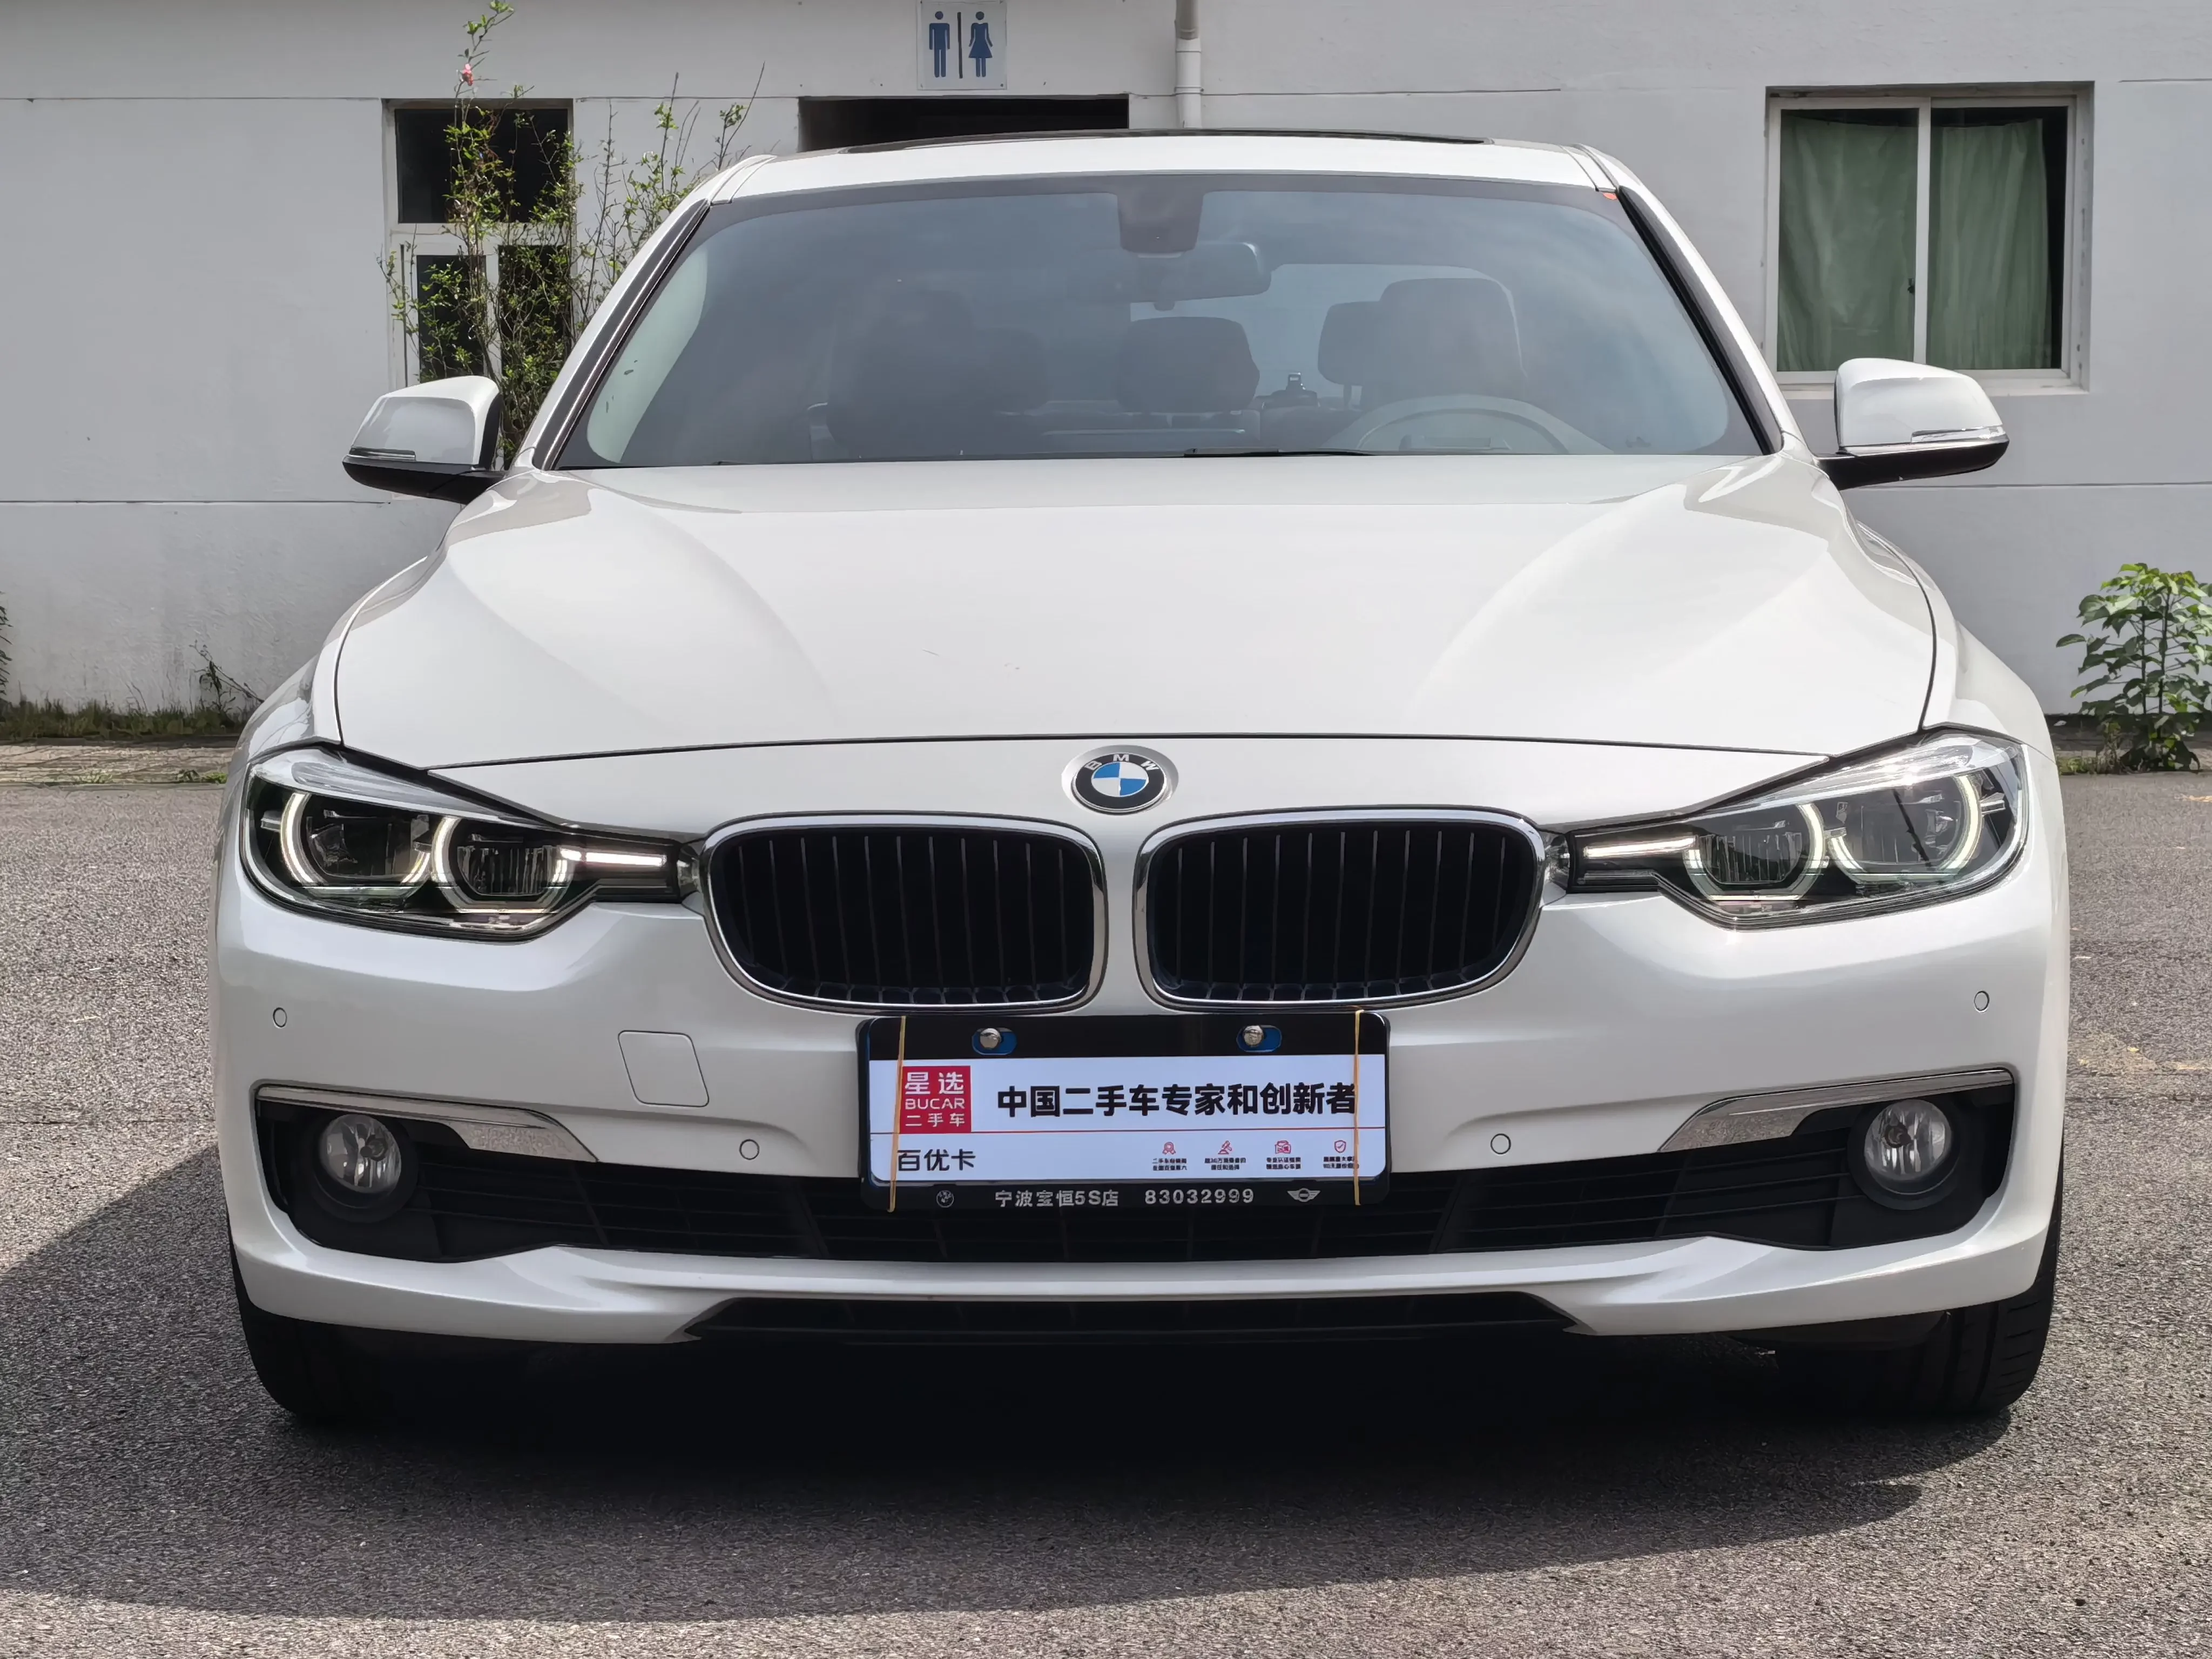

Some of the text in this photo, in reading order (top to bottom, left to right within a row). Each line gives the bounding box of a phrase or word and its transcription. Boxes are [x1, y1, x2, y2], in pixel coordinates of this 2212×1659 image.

[1083, 754, 1159, 771] BMW
[905, 1071, 965, 1095] 星选
[905, 1097, 965, 1110] BUCAR
[997, 1082, 1356, 1117] 中国二手车专家和创新者
[905, 1112, 965, 1127] 二手车
[897, 1149, 976, 1171] 百优卡
[995, 1188, 1254, 1208] 宁波宝恒5S店 83032999
